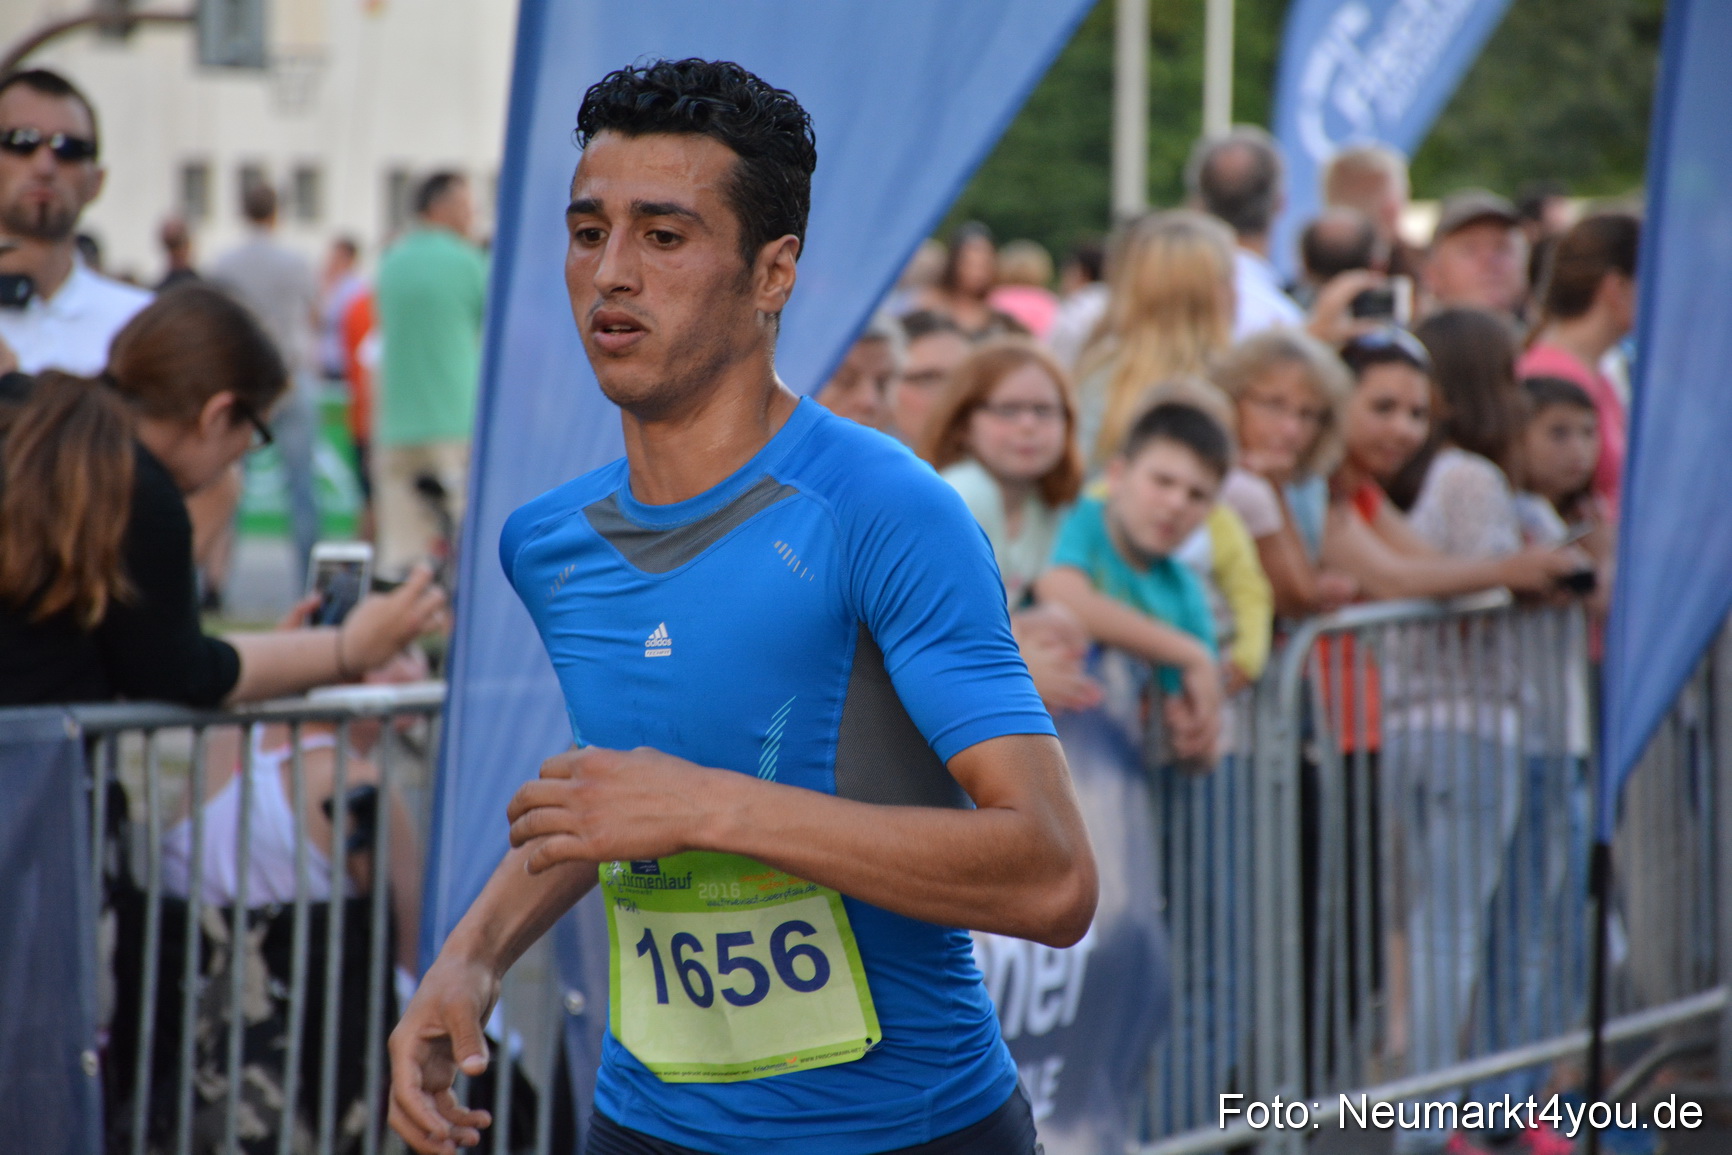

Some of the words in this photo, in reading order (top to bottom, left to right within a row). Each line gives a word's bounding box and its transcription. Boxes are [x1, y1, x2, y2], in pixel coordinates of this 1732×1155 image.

[645, 637, 672, 648] adidas
[621, 868, 692, 891] firmenlauf
[697, 882, 741, 900] 2016
[635, 919, 831, 1009] 1656
[972, 927, 1100, 1040] ner
